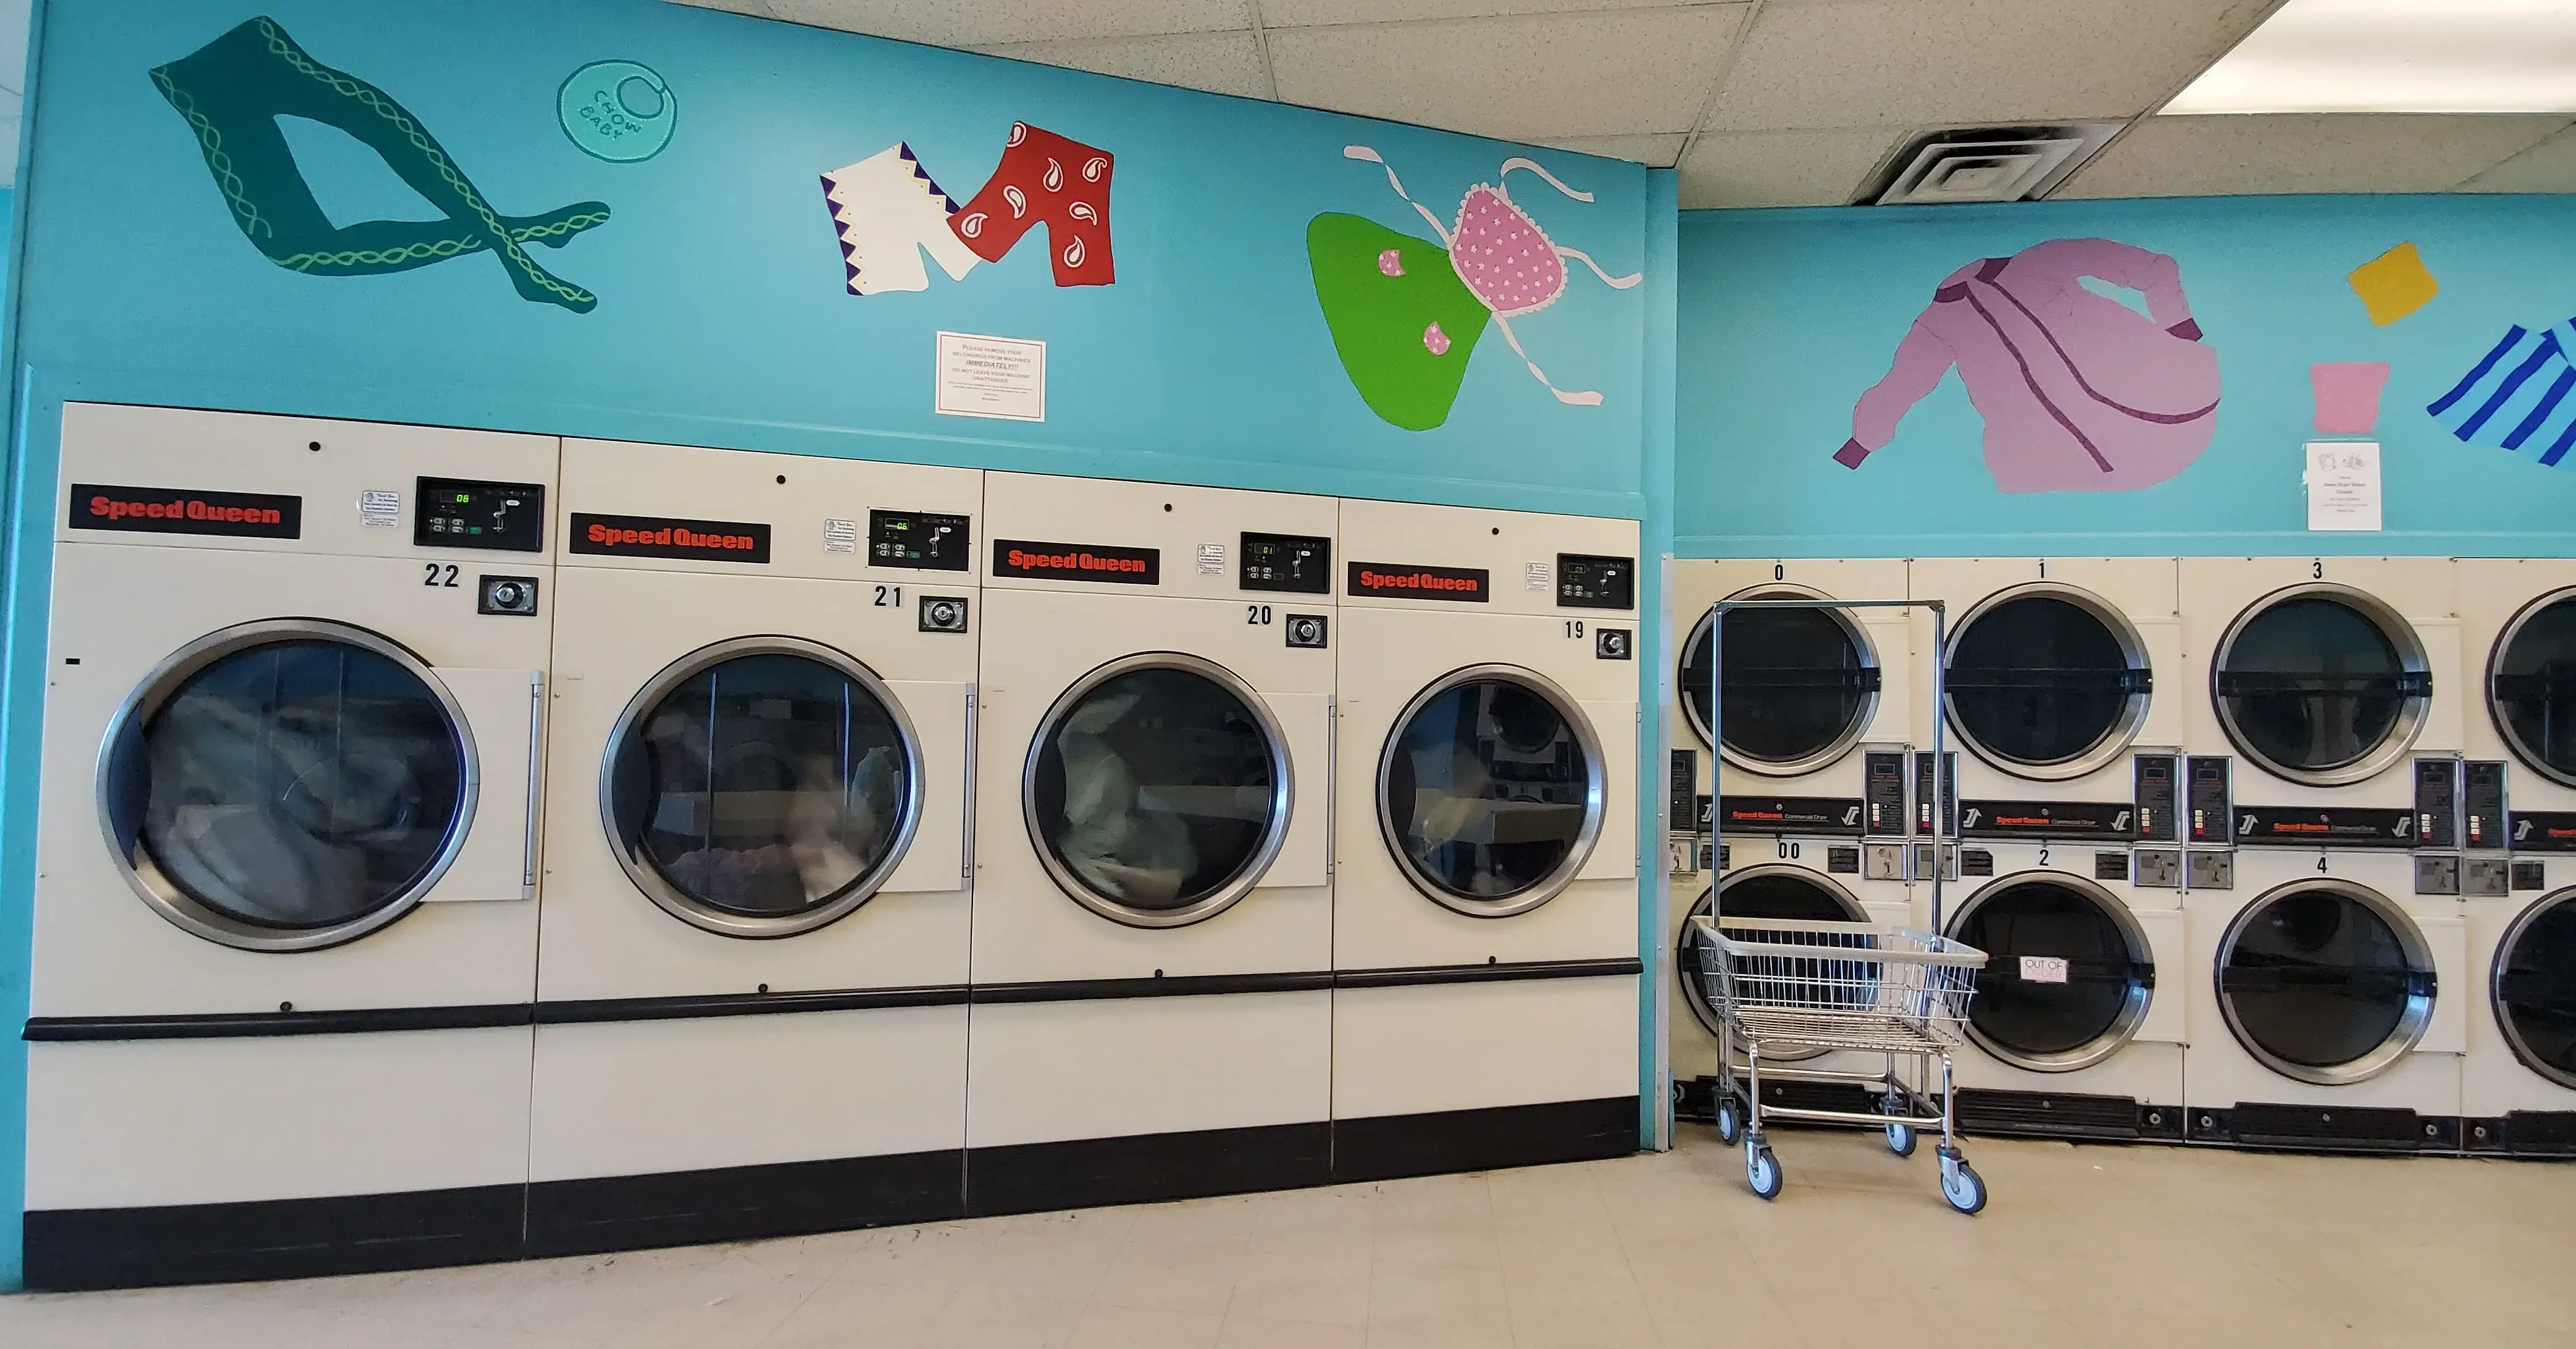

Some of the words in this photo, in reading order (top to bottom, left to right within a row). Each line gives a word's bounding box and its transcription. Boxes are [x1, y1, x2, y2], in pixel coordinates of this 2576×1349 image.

[594, 90, 642, 133] CHOW
[580, 106, 623, 140] BABY
[91, 496, 183, 520] Speed
[186, 500, 280, 524] Queen
[587, 524, 671, 547] Speed
[673, 527, 753, 550] Queen
[1008, 550, 1077, 570] Speed
[1079, 553, 1145, 573] Queen
[2039, 562, 2044, 578] 1
[2313, 561, 2322, 579] 3
[424, 563, 458, 587] 22
[1360, 571, 1419, 589] Speed
[1420, 573, 1478, 591] Queen
[1775, 564, 1783, 581] 0
[874, 586, 900, 607] 21
[1248, 605, 1271, 624] 20
[1566, 621, 1584, 639] 19
[1778, 841, 1800, 859] 00
[2039, 849, 2049, 866] 2
[2317, 857, 2327, 873] 4
[2025, 959, 2045, 969] OUT
[2048, 961, 2062, 969] OF
